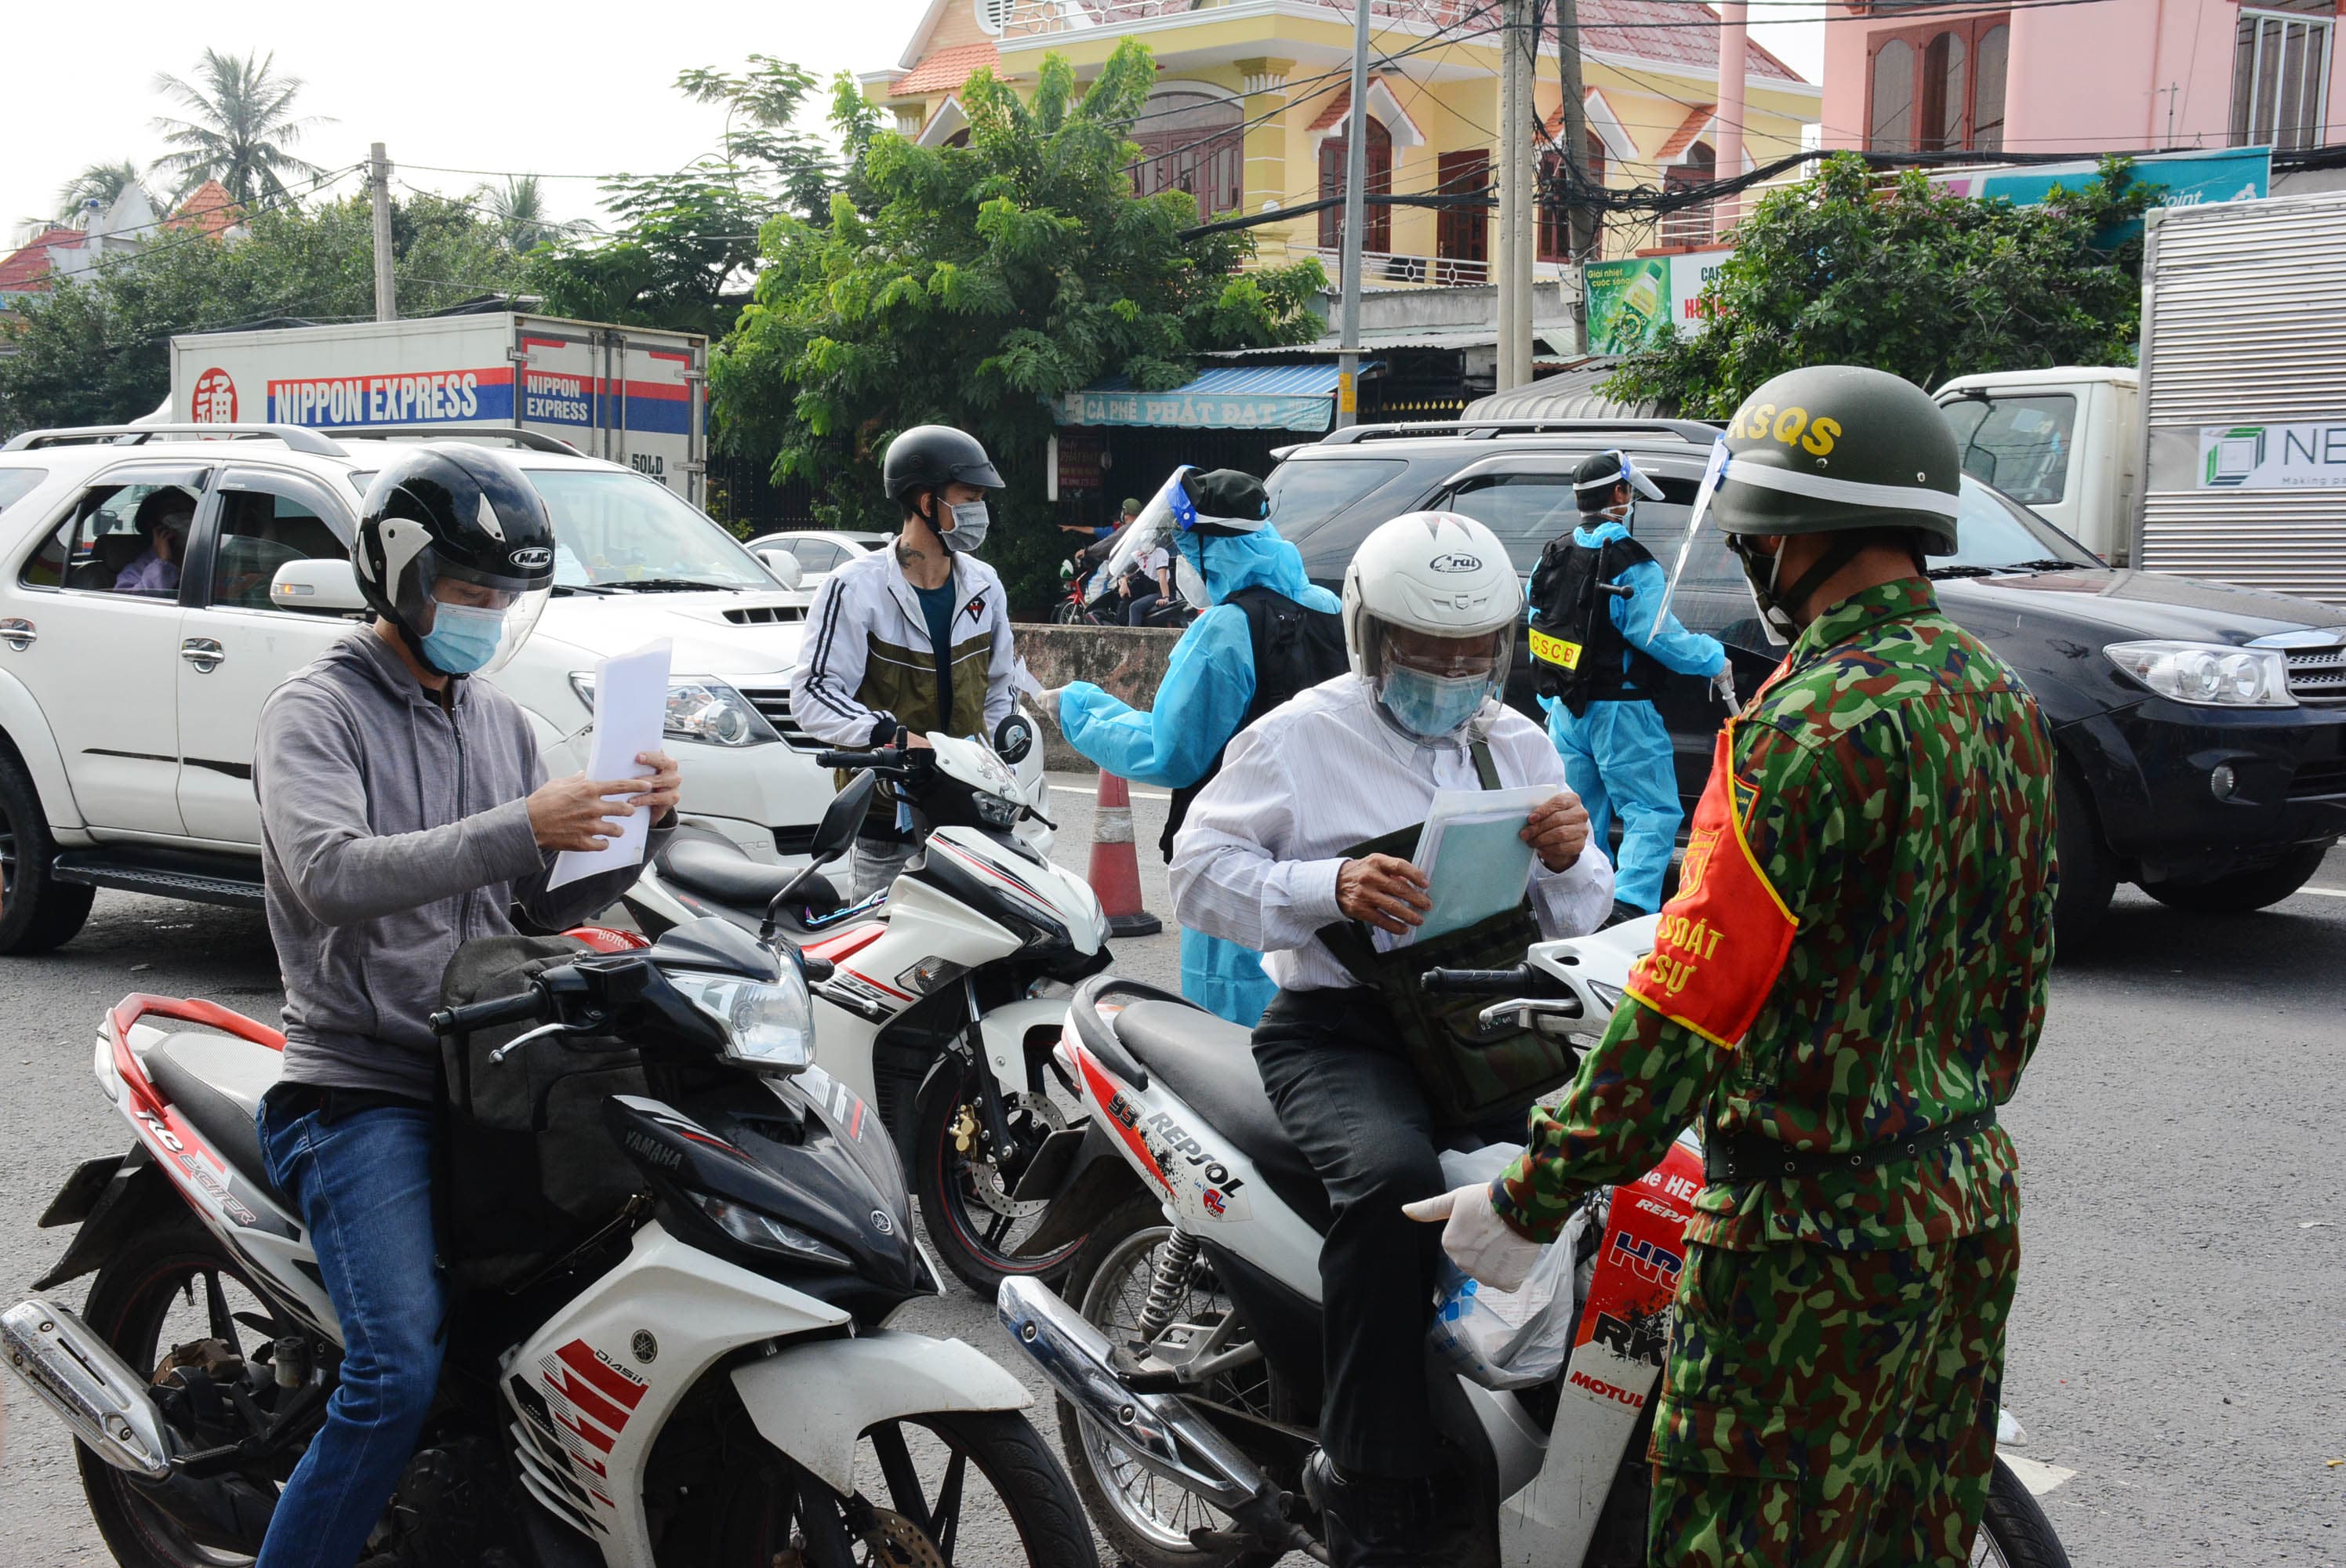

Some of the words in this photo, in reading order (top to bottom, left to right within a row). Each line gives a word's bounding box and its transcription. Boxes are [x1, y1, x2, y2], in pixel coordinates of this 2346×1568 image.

[275, 380, 362, 424] NIPPON
[369, 373, 478, 421] EXPRESS
[527, 375, 580, 397] NIPPON
[527, 397, 588, 421] EXPRESS
[1088, 397, 1105, 419] CÀ
[1109, 398, 1137, 419] PHÊ
[1146, 397, 1214, 423] PHÁT
[1727, 403, 1842, 456] KSQS
[518, 552, 549, 563] HJC
[1532, 635, 1574, 663] CSCĐ
[1658, 914, 1725, 960] SOÁT
[1651, 954, 1698, 998] SỰ
[1107, 1089, 1146, 1130] 93
[625, 1129, 683, 1171] YAMAHA
[1147, 1111, 1245, 1199] REPSOL
[179, 1153, 257, 1225] EXCITER
[1570, 1370, 1644, 1409] MOTUL
